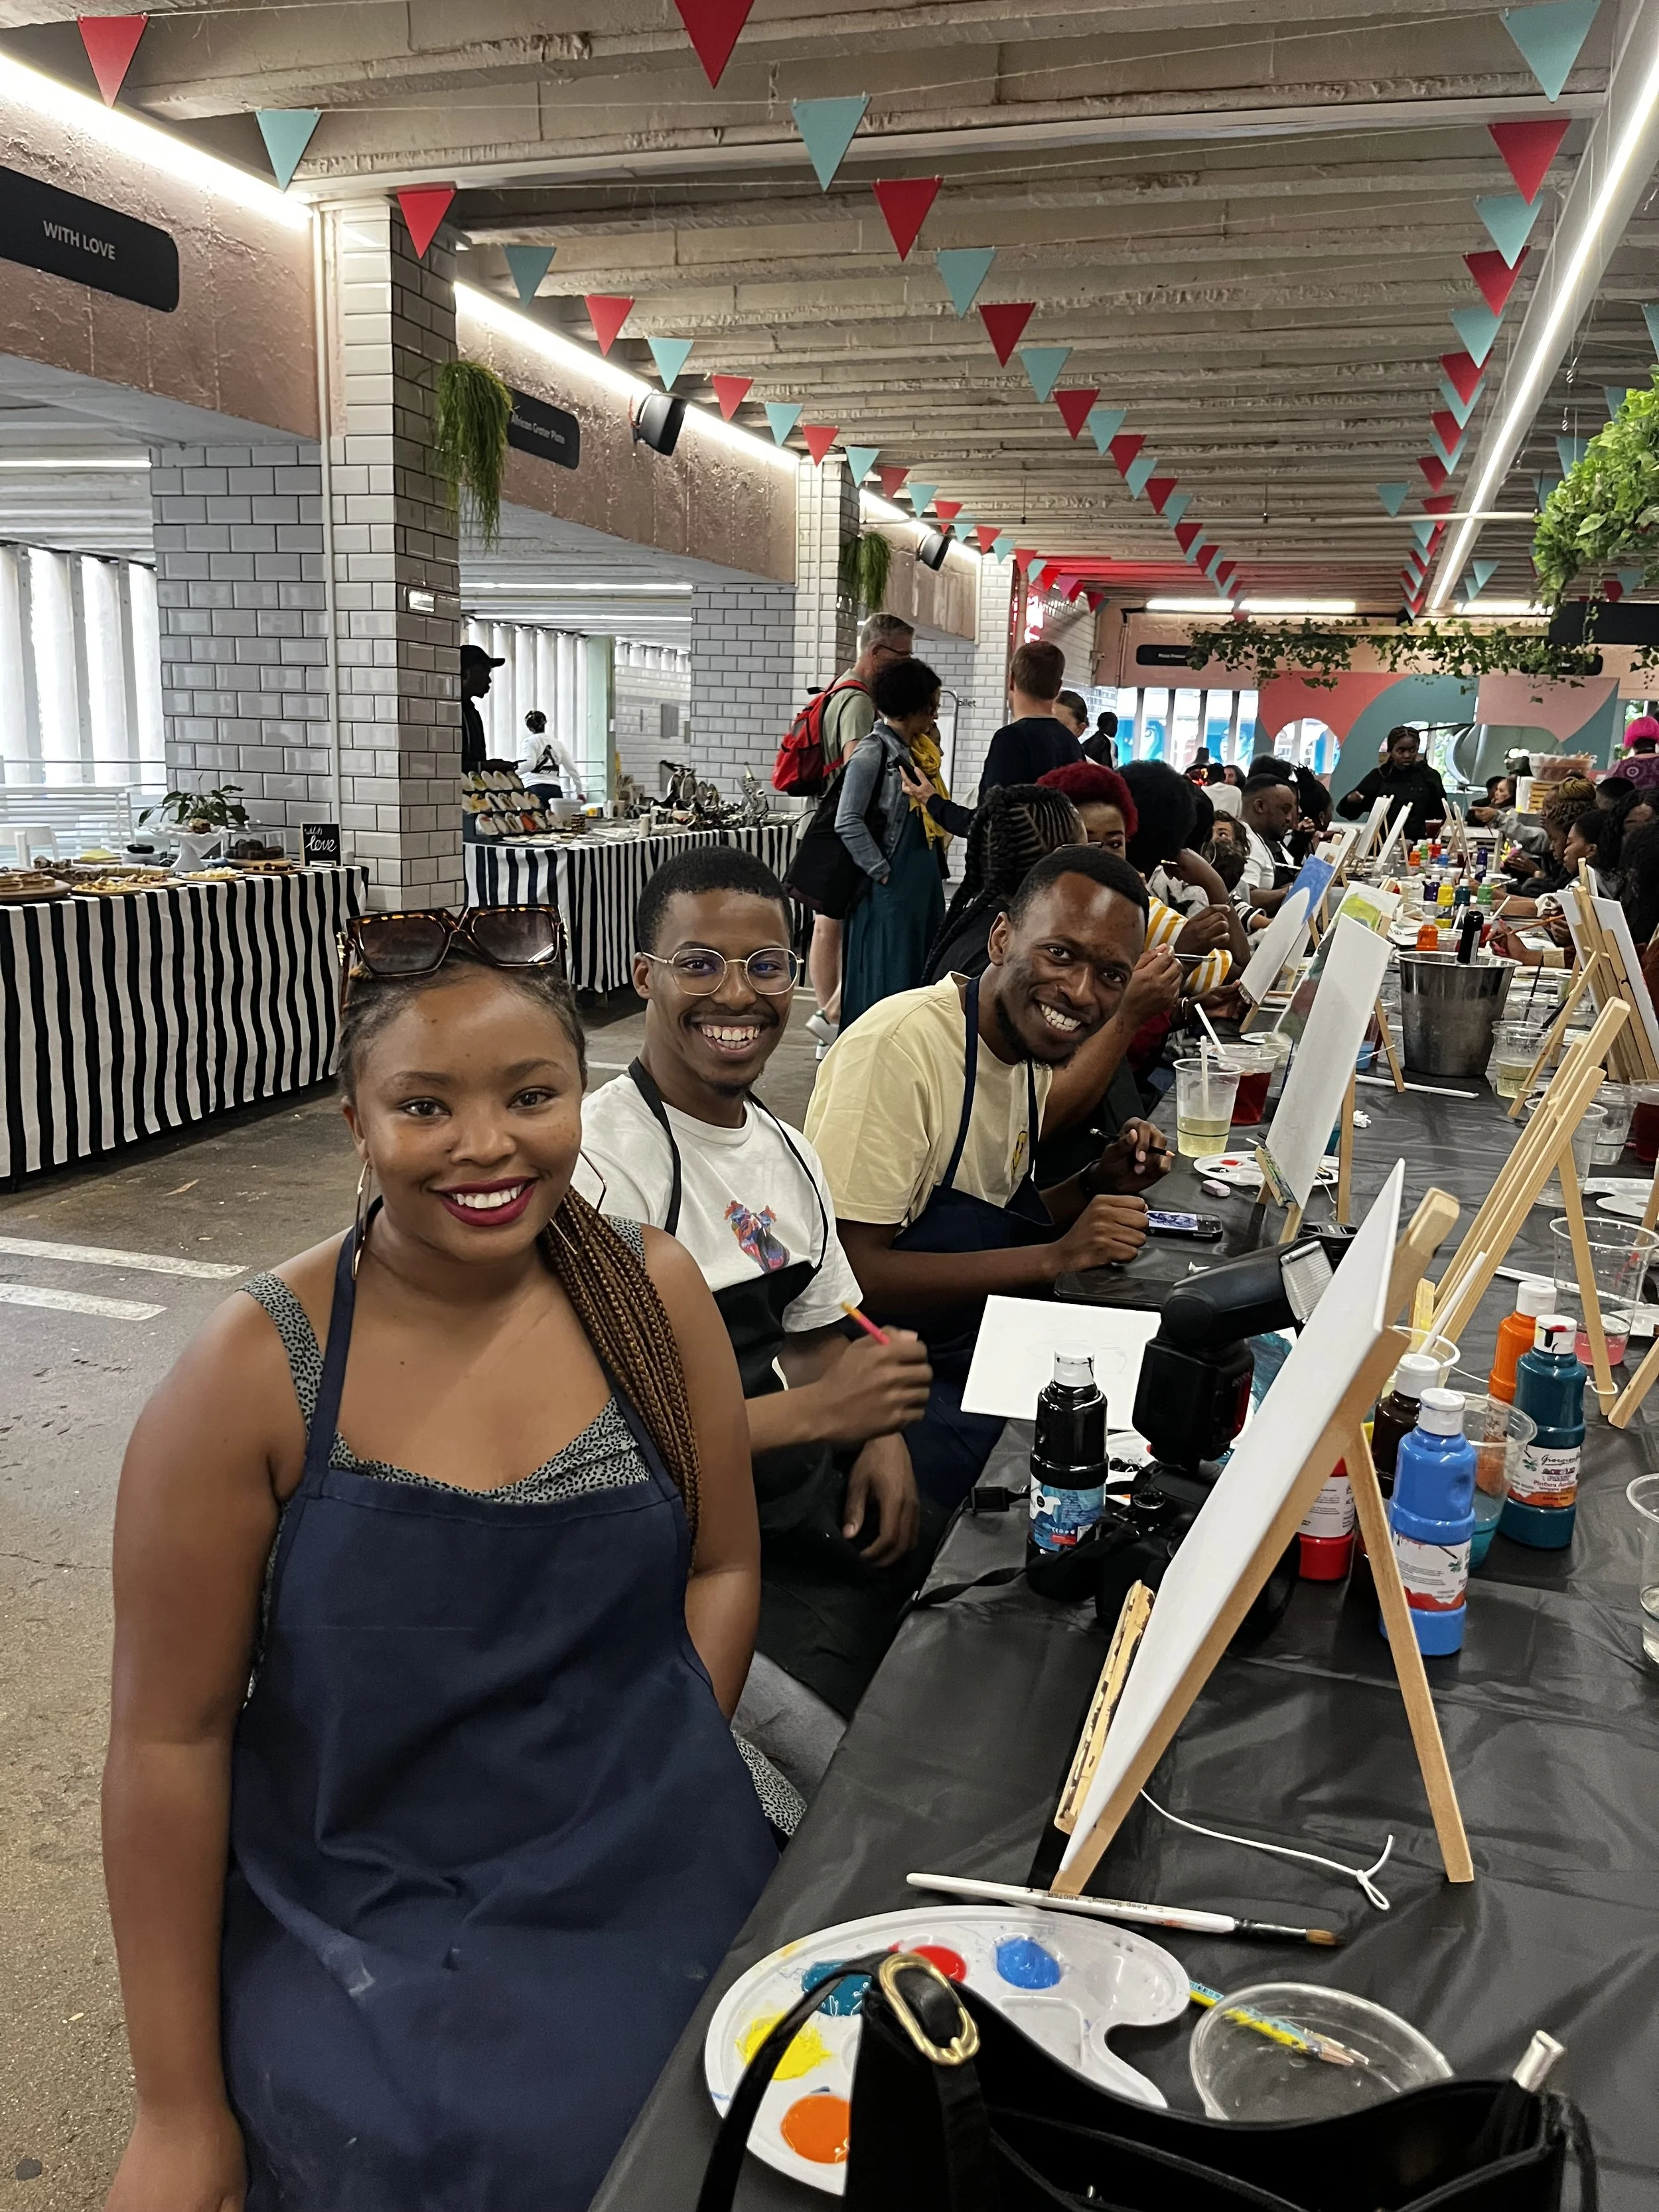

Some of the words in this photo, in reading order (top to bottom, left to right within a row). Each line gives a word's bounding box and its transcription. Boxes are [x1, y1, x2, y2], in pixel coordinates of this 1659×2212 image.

[42, 220, 80, 248] WITH
[82, 234, 116, 261] LOVE
[957, 698, 976, 707] oilet
[305, 834, 337, 852] love
[1126, 1902, 1147, 1911] Keep
